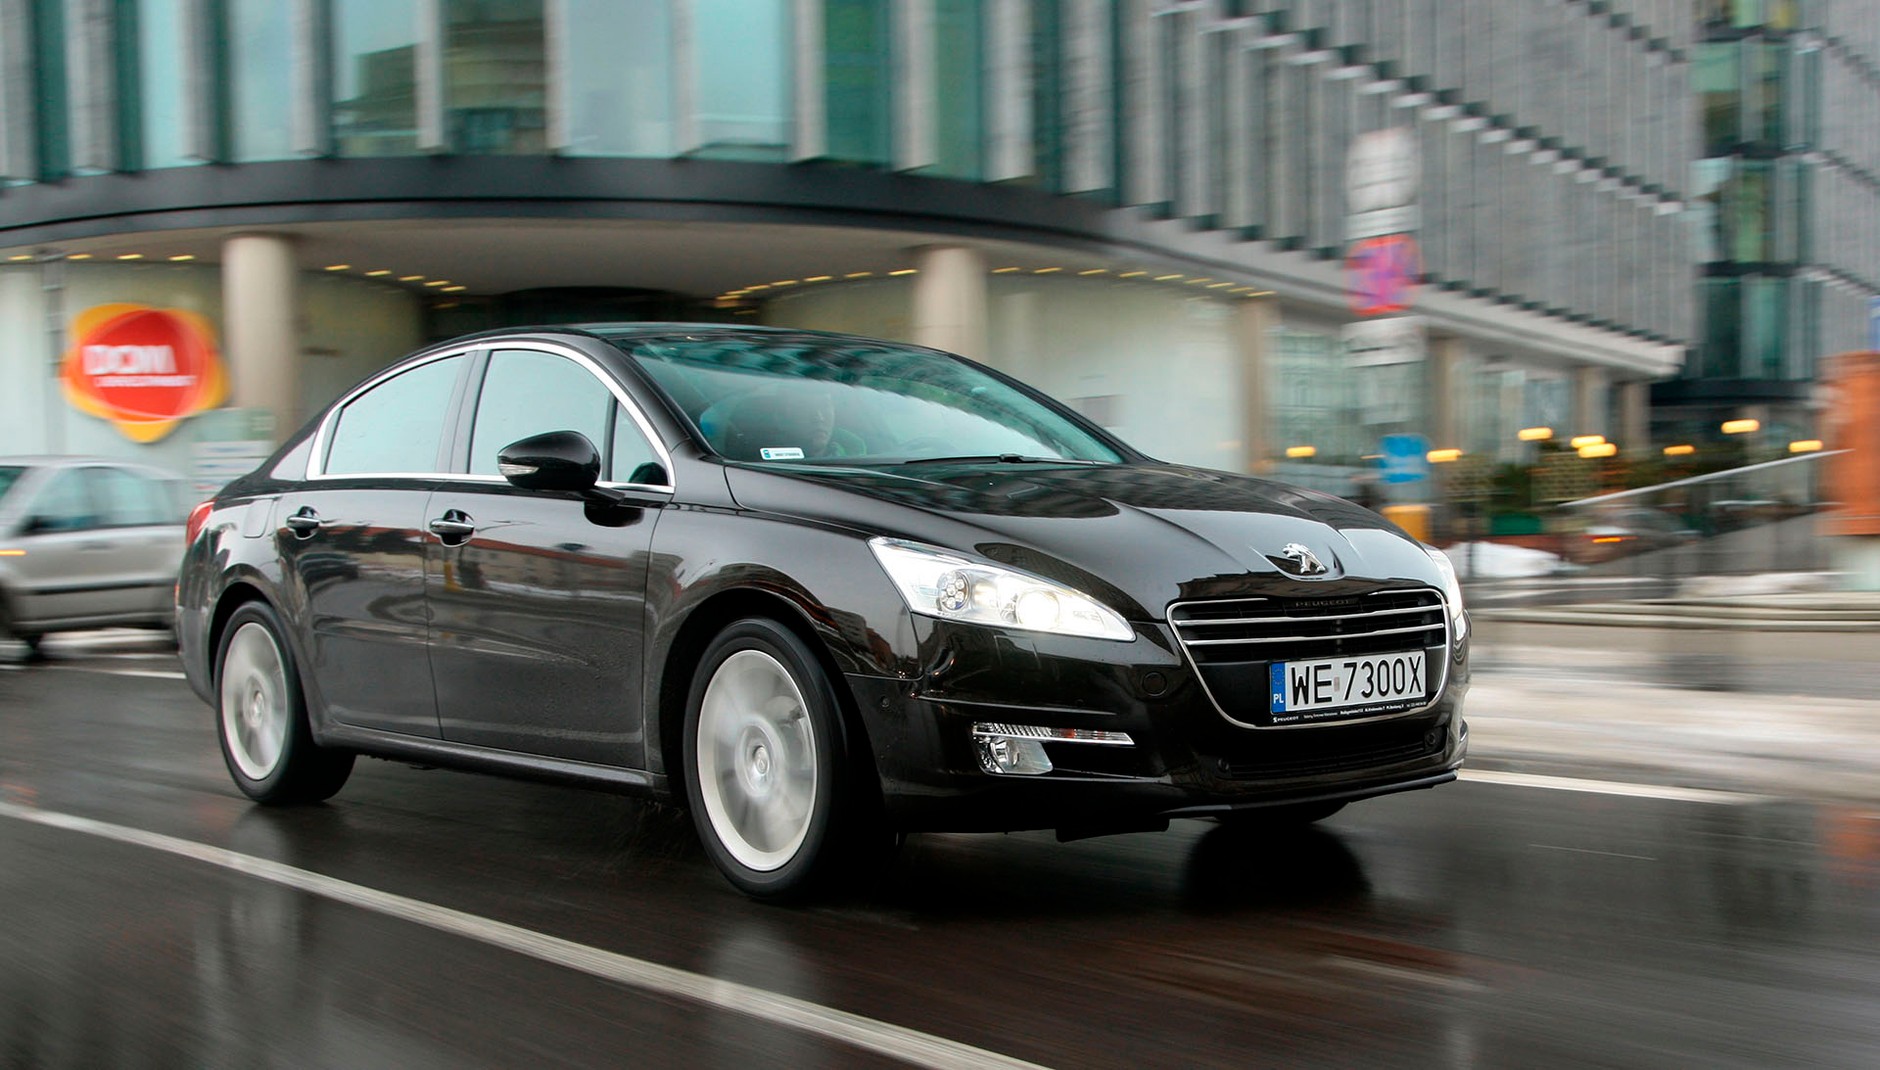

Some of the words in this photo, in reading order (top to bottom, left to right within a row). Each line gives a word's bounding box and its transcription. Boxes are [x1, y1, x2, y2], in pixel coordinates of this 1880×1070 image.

[1295, 599, 1350, 607] PEUGEOT
[1291, 664, 1333, 706] WE
[1343, 656, 1422, 701] 7300X
[1273, 693, 1285, 704] PL
